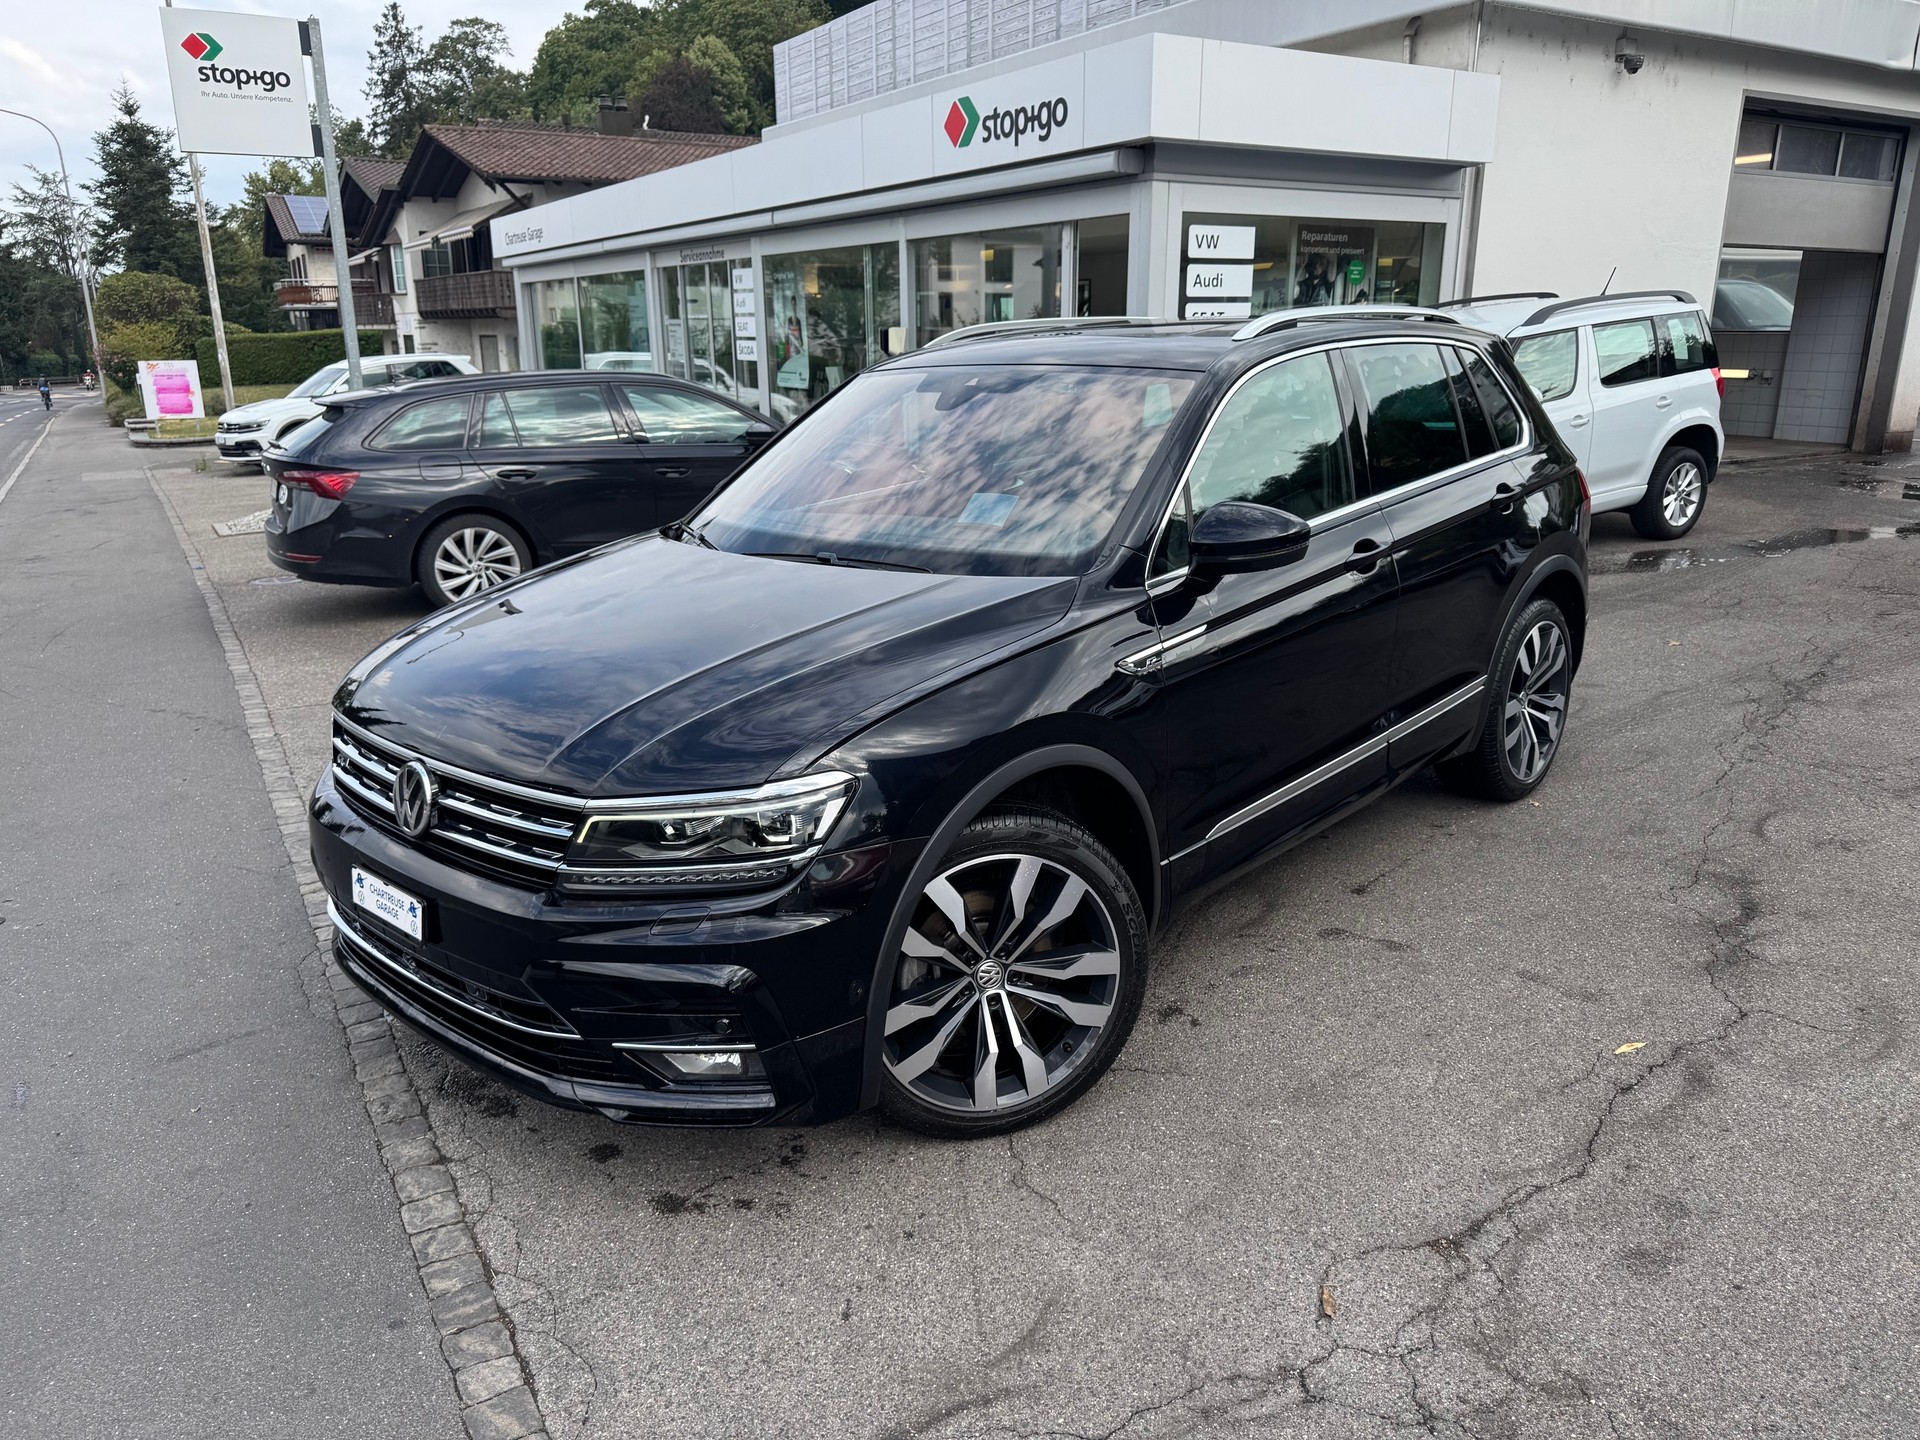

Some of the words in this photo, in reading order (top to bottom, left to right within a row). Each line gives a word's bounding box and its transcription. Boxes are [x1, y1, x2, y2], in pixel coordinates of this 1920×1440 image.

[198, 63, 291, 92] stop+go
[212, 91, 230, 99] Auto.
[254, 94, 293, 102] Kompetenz.
[982, 97, 1068, 147] stop+go
[1195, 234, 1220, 250] VW
[1301, 230, 1348, 243] Reparaturen
[1193, 273, 1223, 288] Audi
[370, 883, 405, 911] CHARTREUSE
[376, 899, 399, 920] GARAGE
